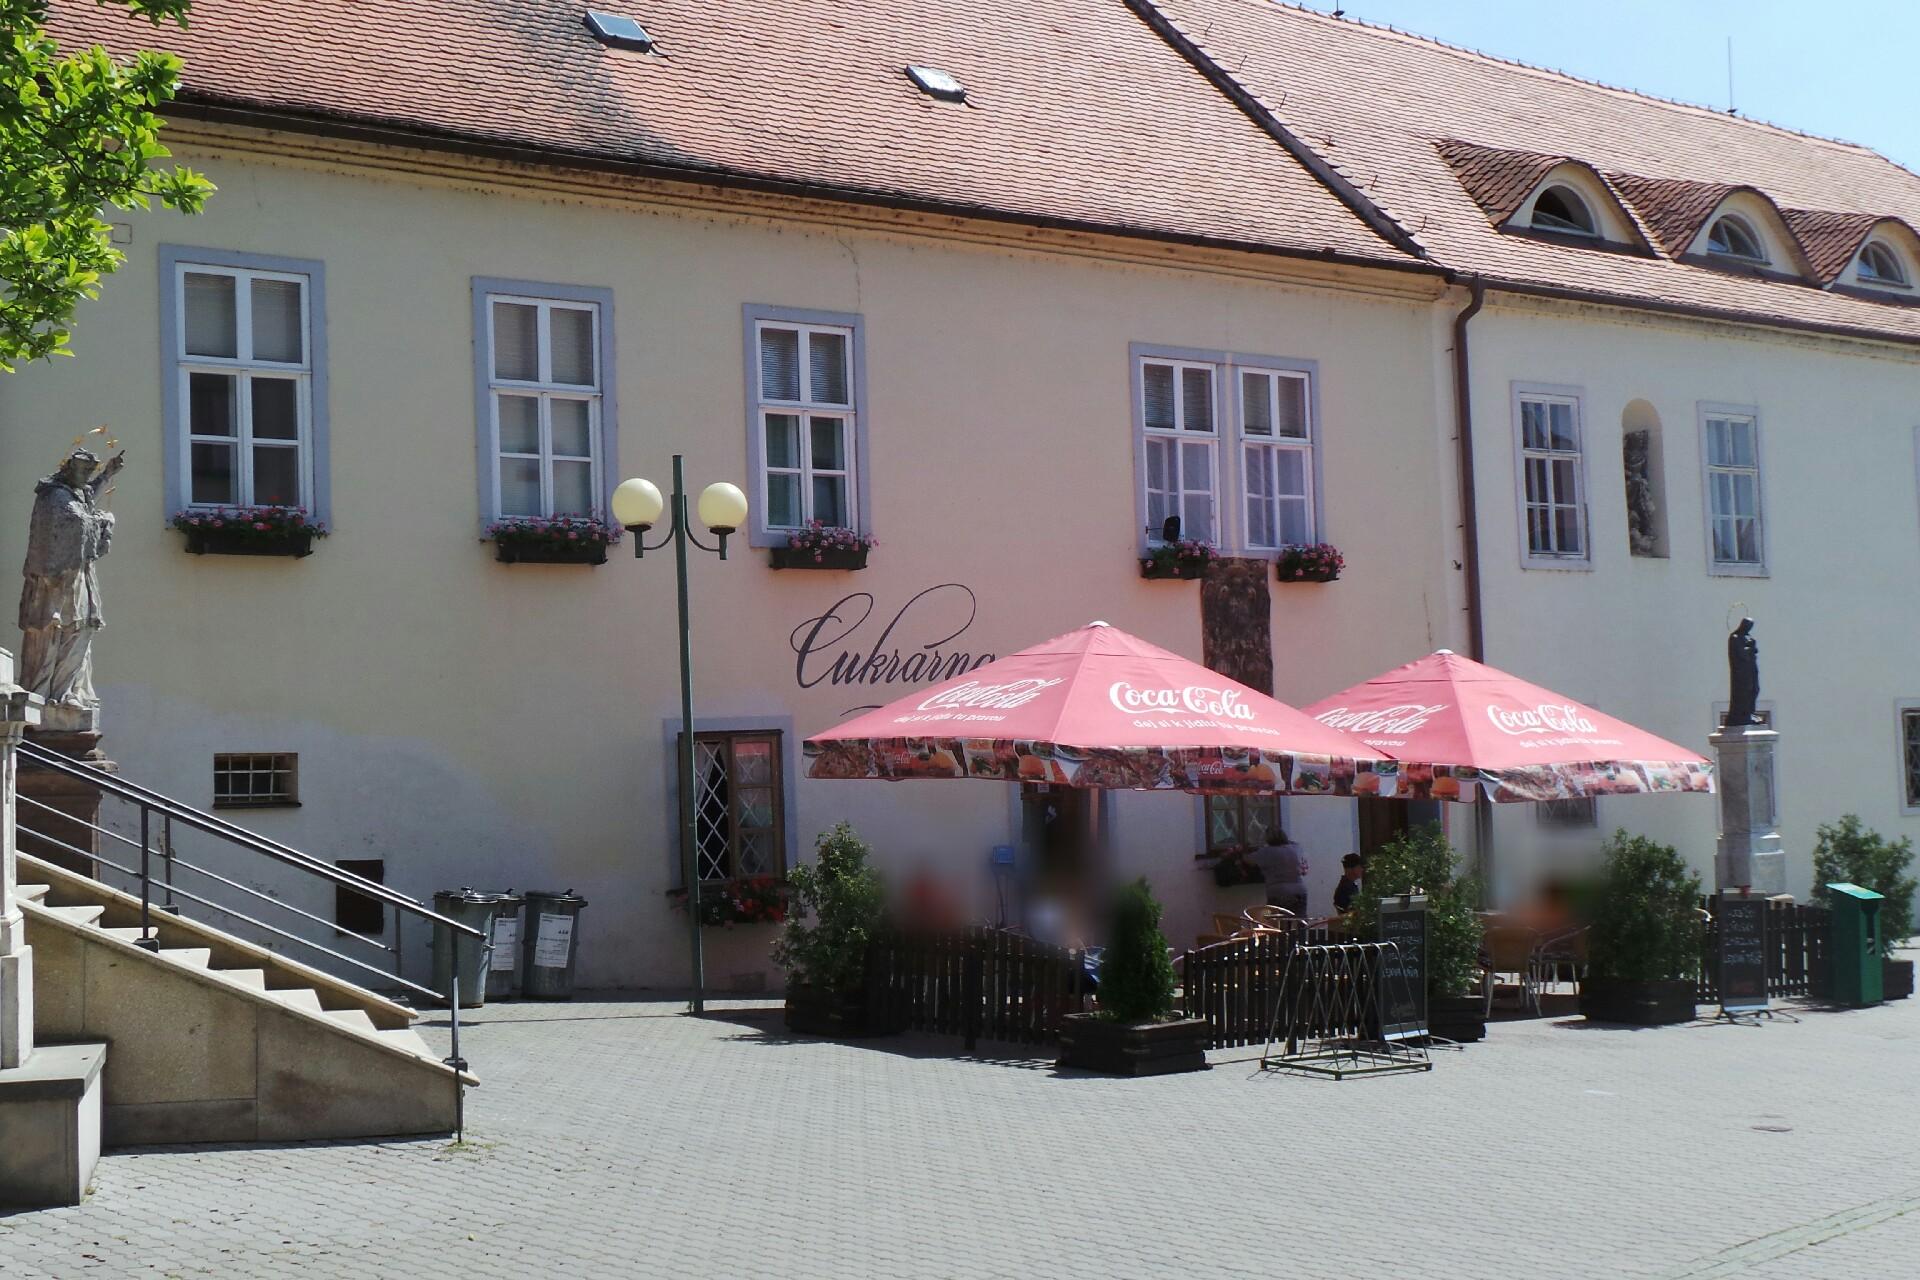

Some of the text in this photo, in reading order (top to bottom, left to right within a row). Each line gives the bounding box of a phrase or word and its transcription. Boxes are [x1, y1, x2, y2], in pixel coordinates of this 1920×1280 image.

[917, 678, 1067, 711] Coca-Cola
[1109, 681, 1255, 720] Coca-Cola
[1487, 704, 1597, 735] Coca-Cola
